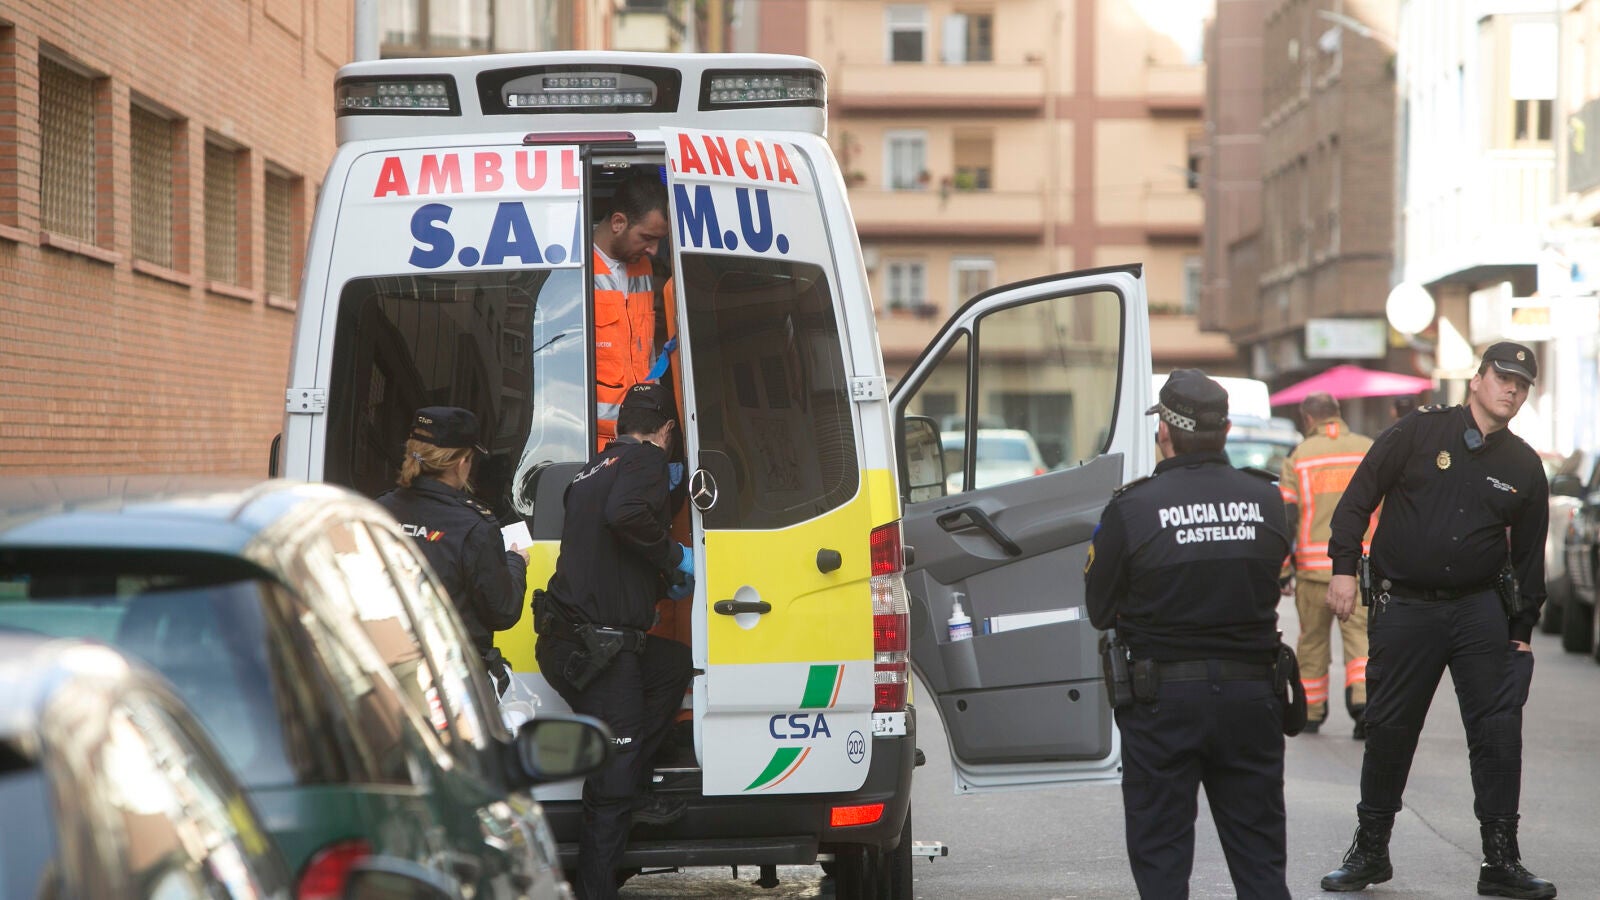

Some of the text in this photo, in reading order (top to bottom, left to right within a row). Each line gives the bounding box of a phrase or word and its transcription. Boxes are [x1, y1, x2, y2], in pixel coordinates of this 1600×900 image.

[573, 457, 609, 483] OLICIA
[1158, 502, 1264, 528] POLICIA LOCAL
[1175, 522, 1256, 544] CASTELLÓN
[769, 713, 832, 739] CSA
[848, 740, 864, 755] 202
